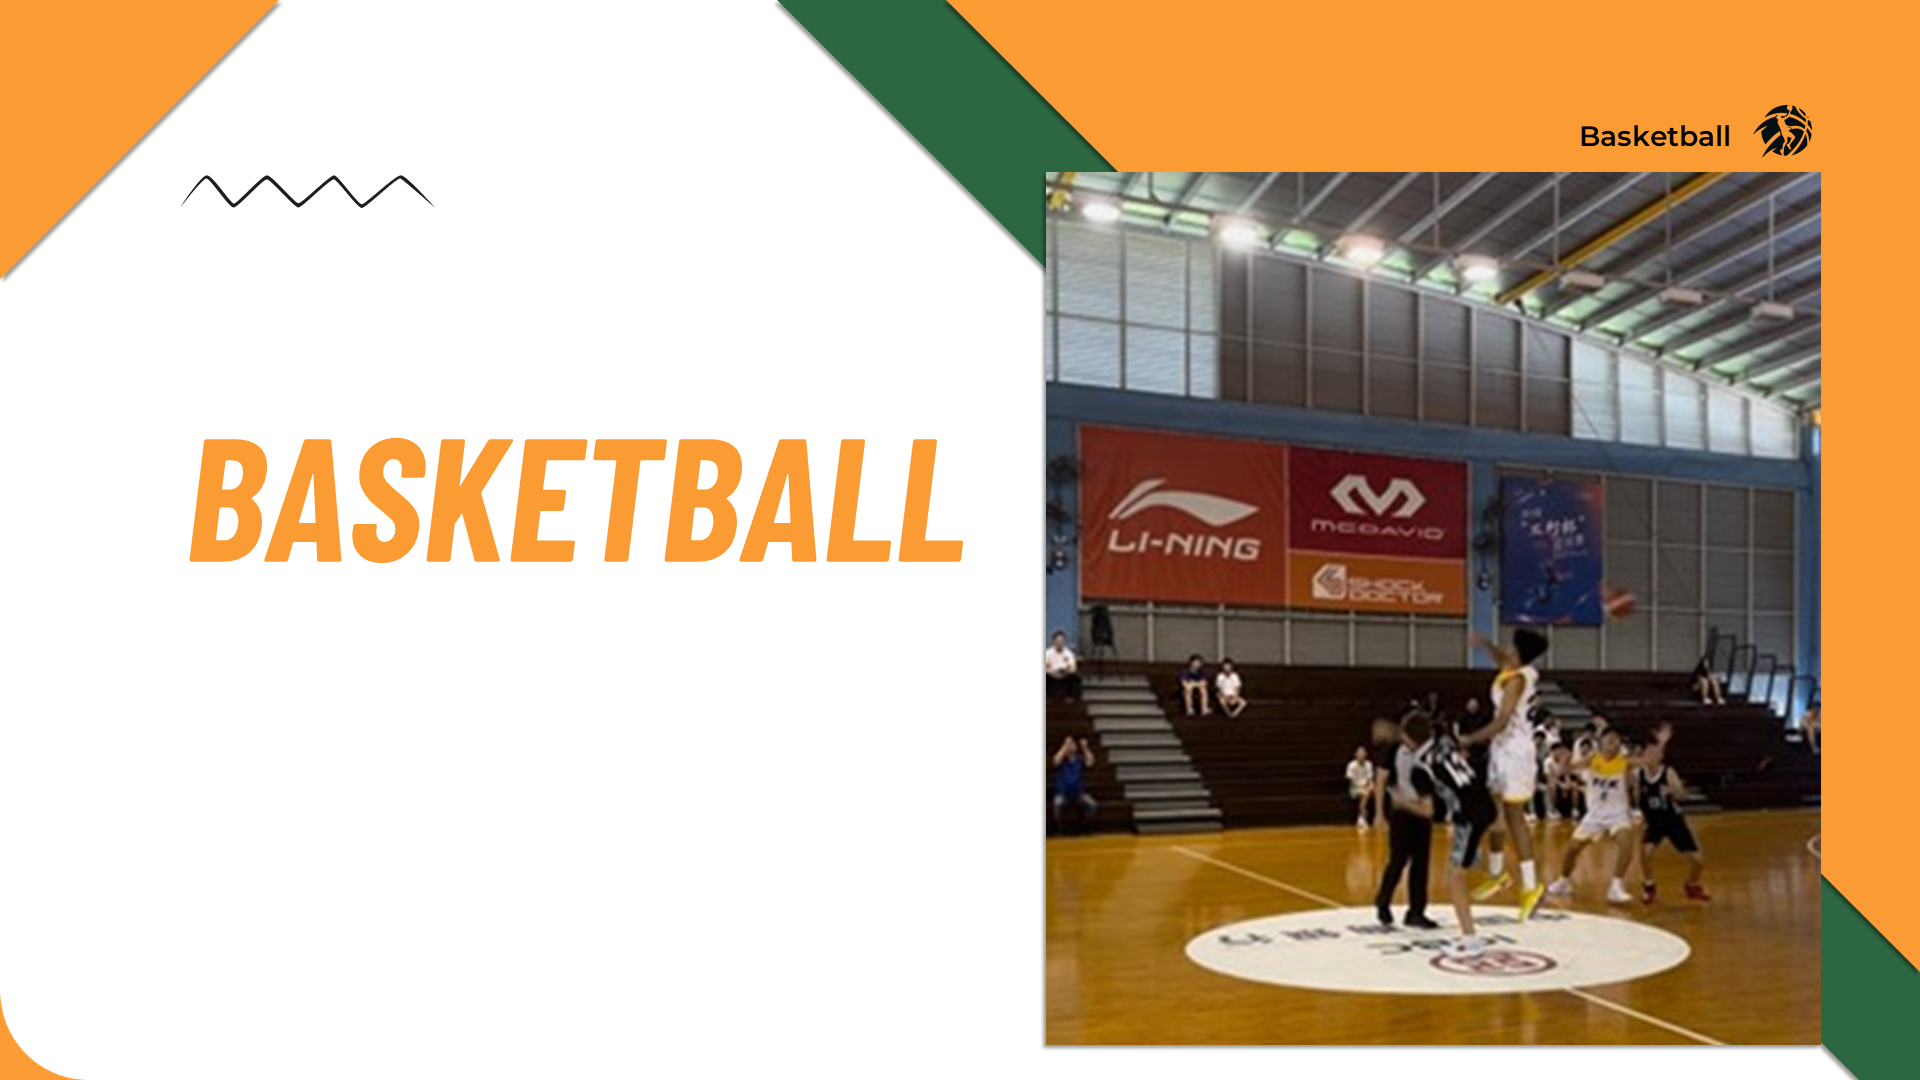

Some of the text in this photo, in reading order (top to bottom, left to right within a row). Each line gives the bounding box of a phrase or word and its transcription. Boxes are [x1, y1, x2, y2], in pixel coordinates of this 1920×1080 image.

[1108, 529, 1262, 561] LI-NING
[1348, 577, 1424, 593] SHOCK
[1349, 589, 1444, 604] DOCTOR
